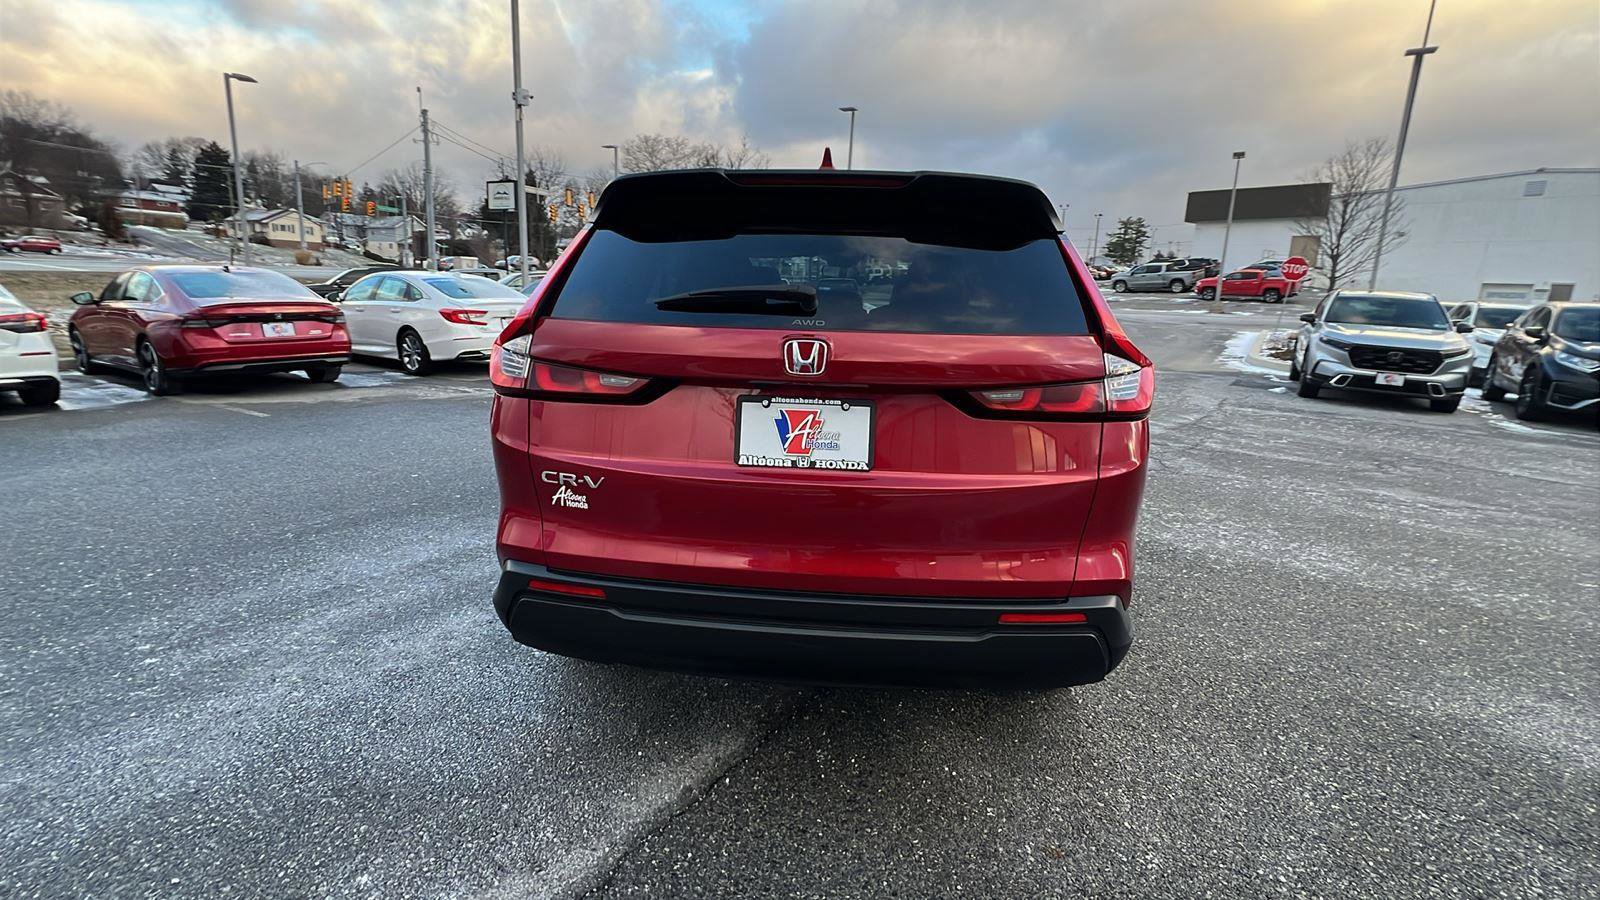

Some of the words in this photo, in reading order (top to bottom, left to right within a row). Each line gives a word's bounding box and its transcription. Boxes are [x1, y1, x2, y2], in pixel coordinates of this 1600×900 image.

[1282, 263, 1308, 274] STOP
[792, 319, 826, 327] AWD
[771, 396, 842, 405] altoonahonda.com
[806, 439, 840, 450] Honda
[738, 454, 792, 467] Altoona
[815, 459, 869, 470] HONDA
[541, 470, 605, 489] CR-V
[551, 485, 587, 507] Altoona
[566, 500, 589, 510] Honda
